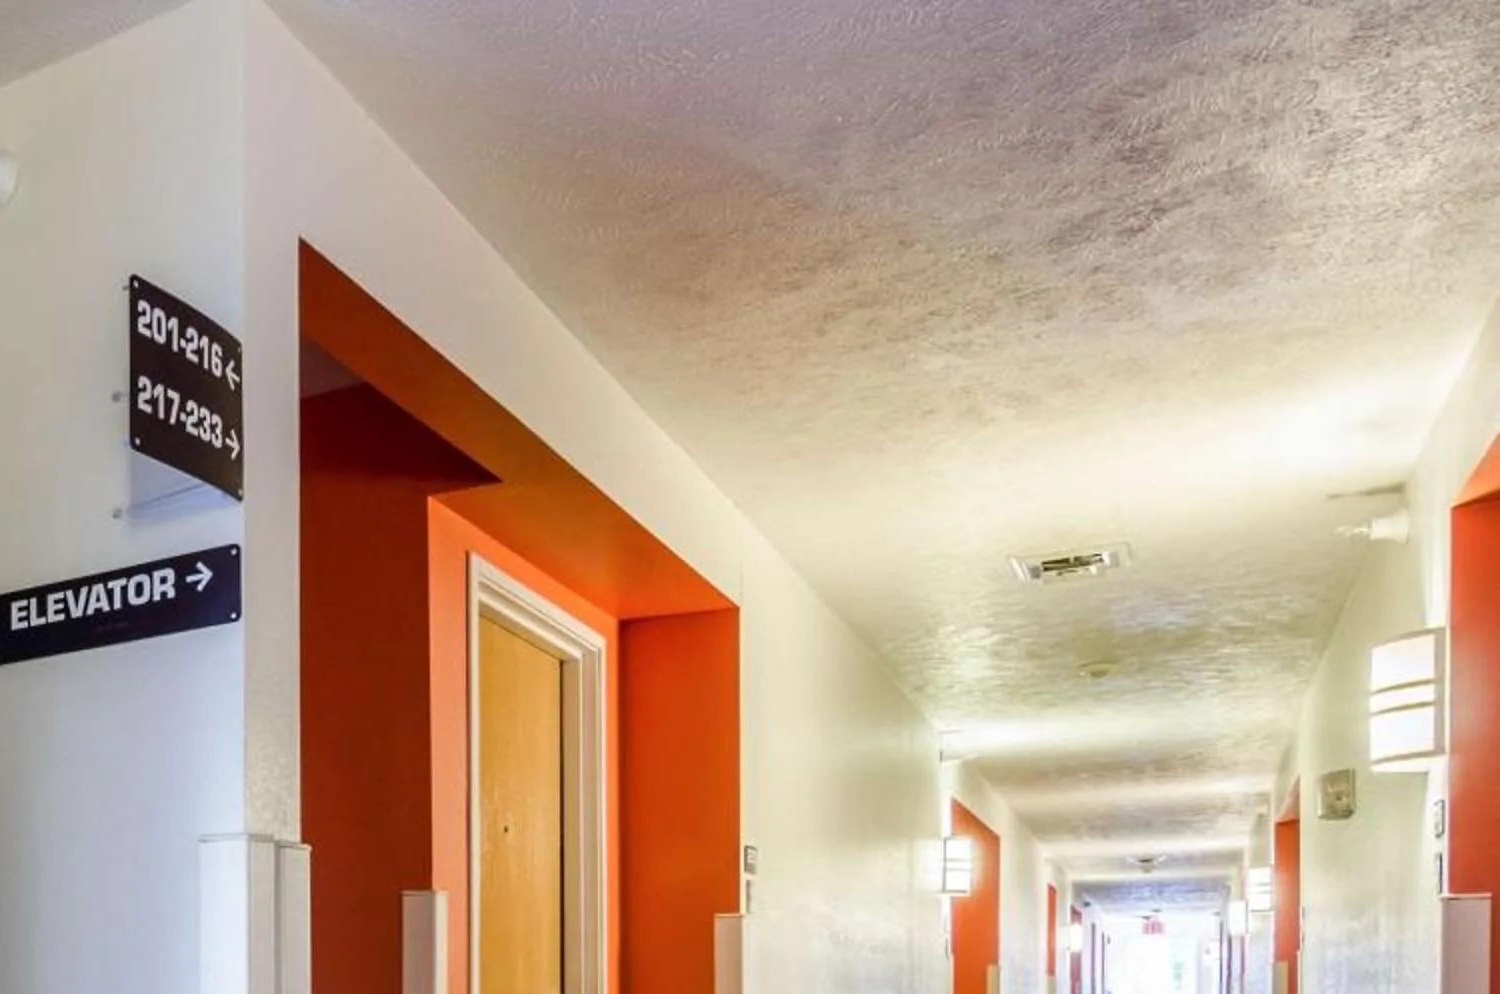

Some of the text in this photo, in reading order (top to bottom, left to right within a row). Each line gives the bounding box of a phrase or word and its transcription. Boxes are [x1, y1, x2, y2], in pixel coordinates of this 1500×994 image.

[137, 299, 223, 378] 201-216
[137, 375, 223, 449] 217-233
[10, 568, 176, 631] ELEVATOR
